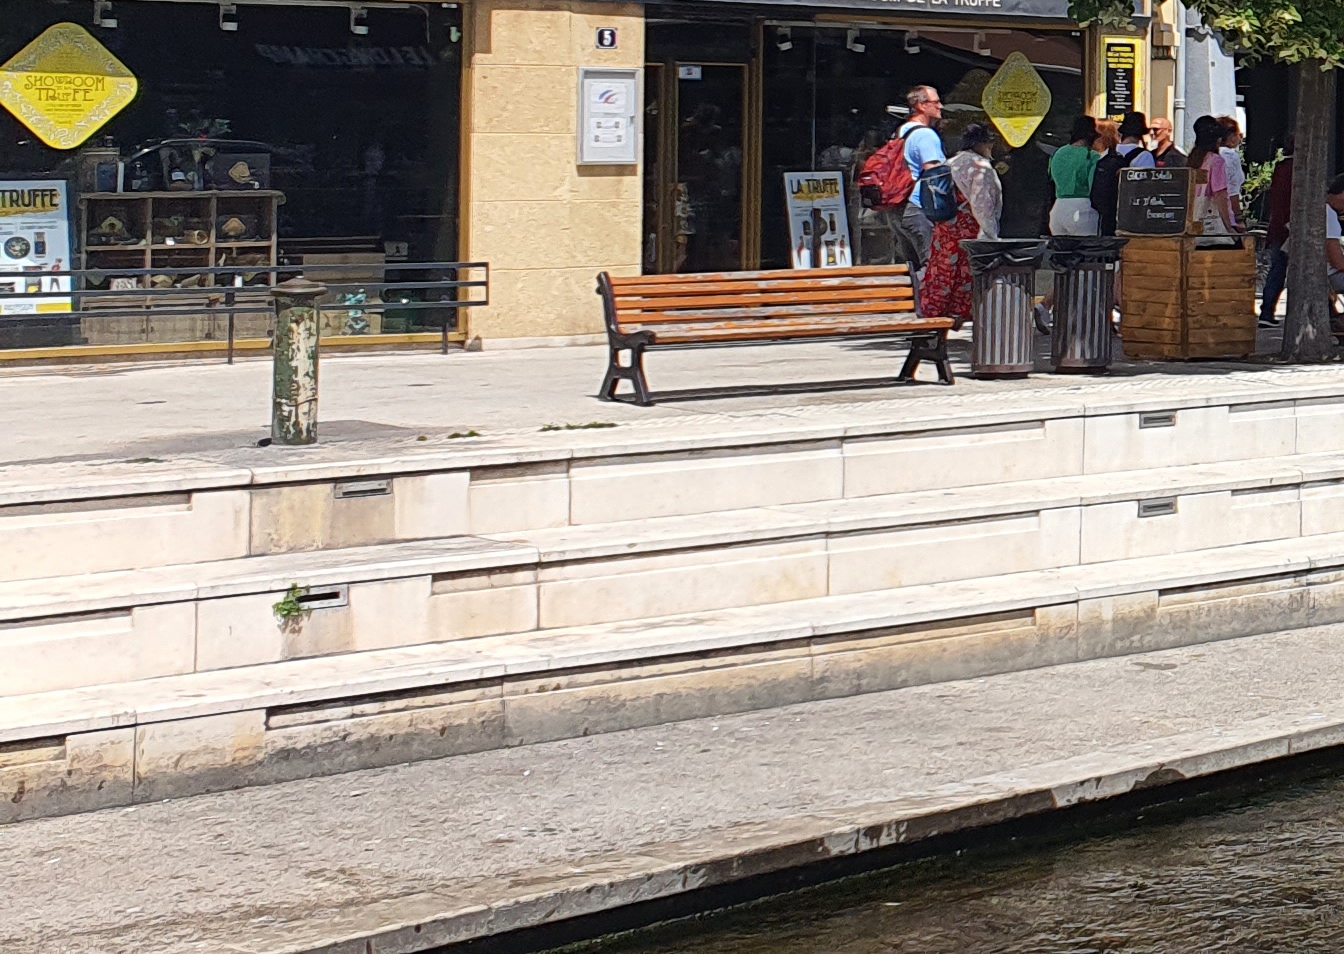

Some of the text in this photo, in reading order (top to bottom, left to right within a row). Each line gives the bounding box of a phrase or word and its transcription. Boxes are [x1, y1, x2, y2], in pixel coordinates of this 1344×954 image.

[602, 30, 612, 45] 5
[24, 75, 105, 91] SHOWROOM
[0, 188, 60, 208] TRUFFE
